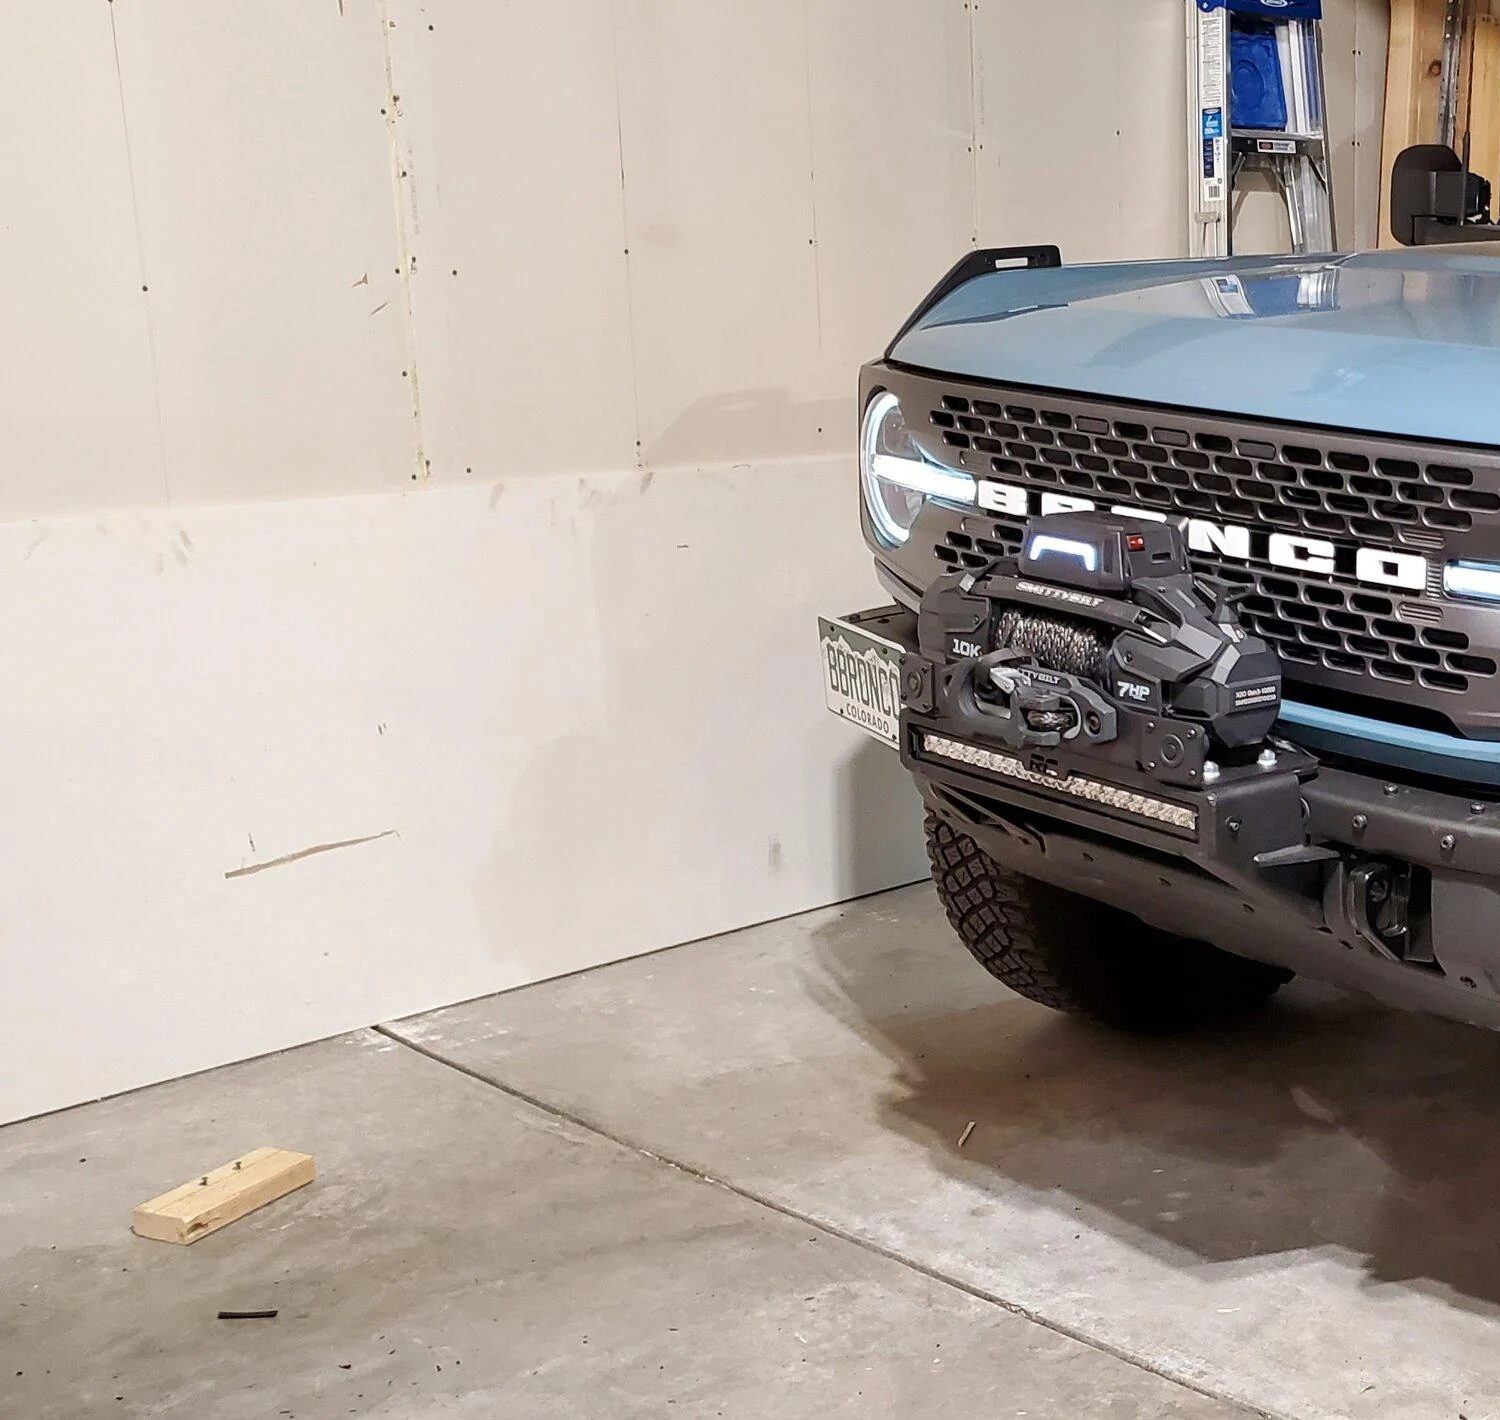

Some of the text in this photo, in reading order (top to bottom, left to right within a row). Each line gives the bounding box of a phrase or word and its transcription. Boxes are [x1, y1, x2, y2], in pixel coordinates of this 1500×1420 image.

[977, 480, 1428, 591] BRNCO
[952, 638, 983, 658] 10K
[826, 642, 901, 721] BBRONCO
[1117, 681, 1151, 701] 7HP
[846, 703, 889, 734] COLORADO
